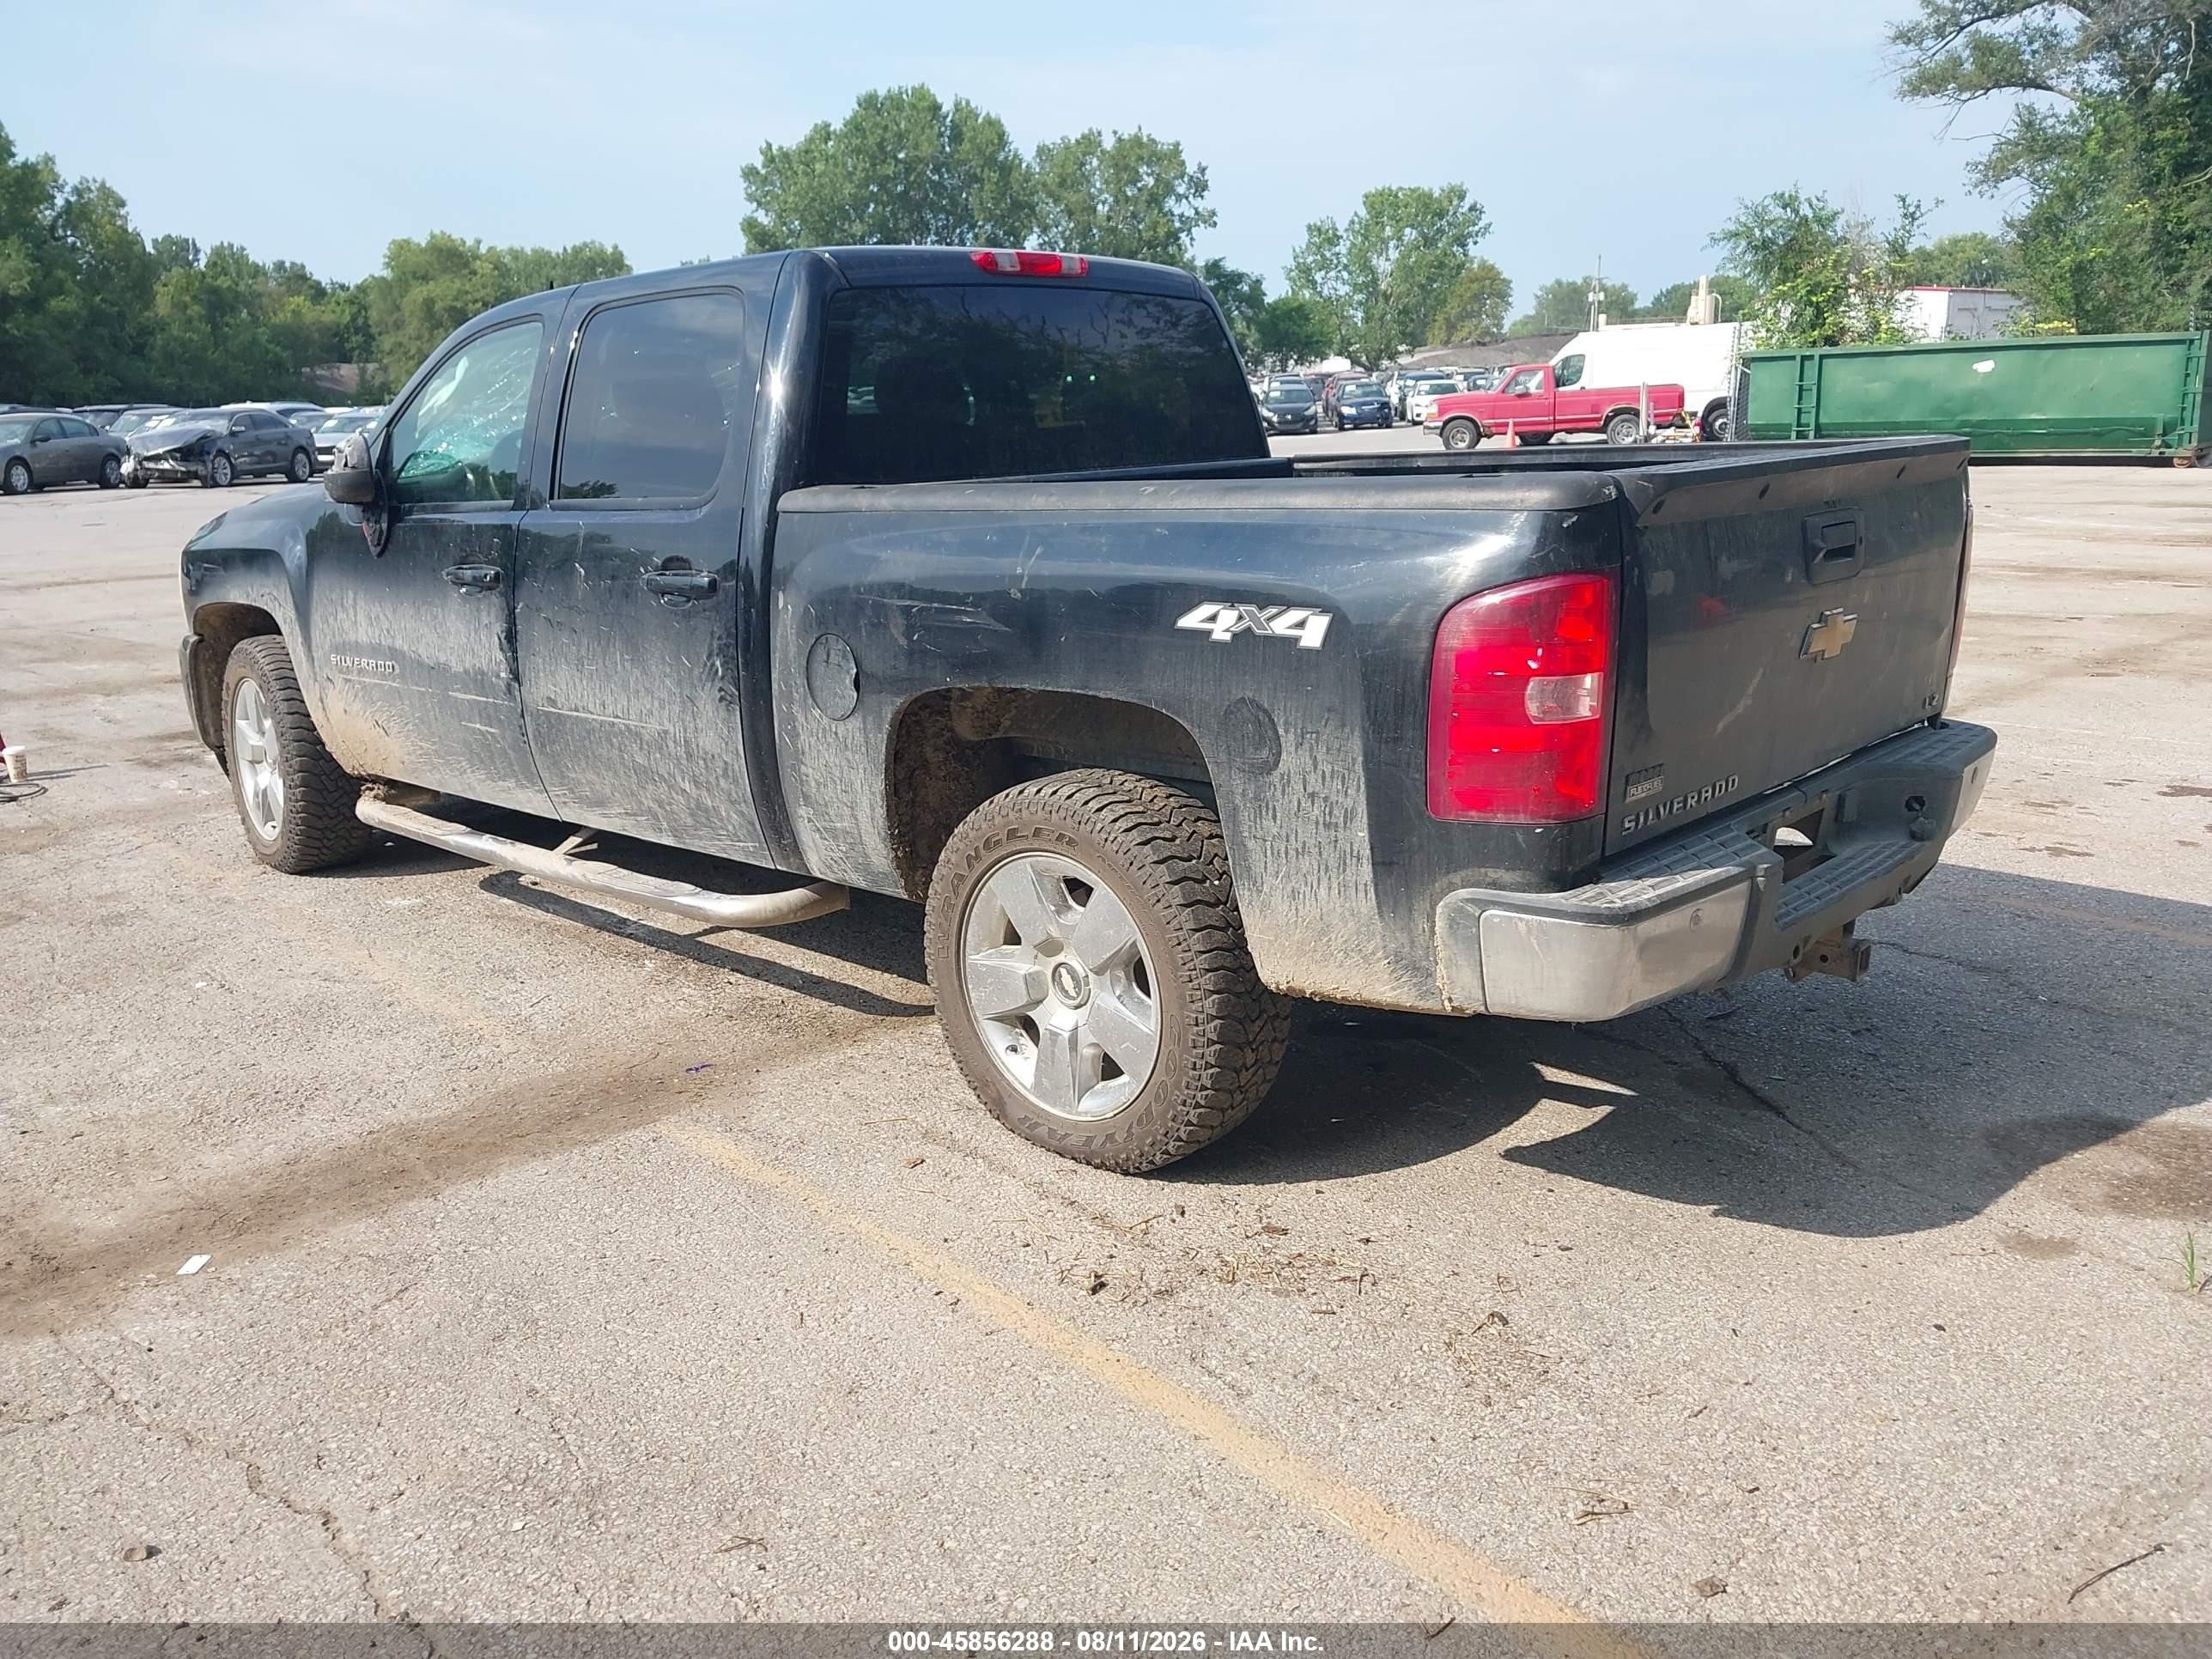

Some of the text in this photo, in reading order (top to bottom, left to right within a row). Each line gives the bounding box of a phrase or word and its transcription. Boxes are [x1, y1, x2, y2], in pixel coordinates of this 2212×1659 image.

[330, 653, 394, 672] SILVERADO
[1622, 775, 1739, 836] SILVERADO
[937, 825, 1079, 959] WRANGLER
[1017, 1013, 1182, 1150] GOODYEAR
